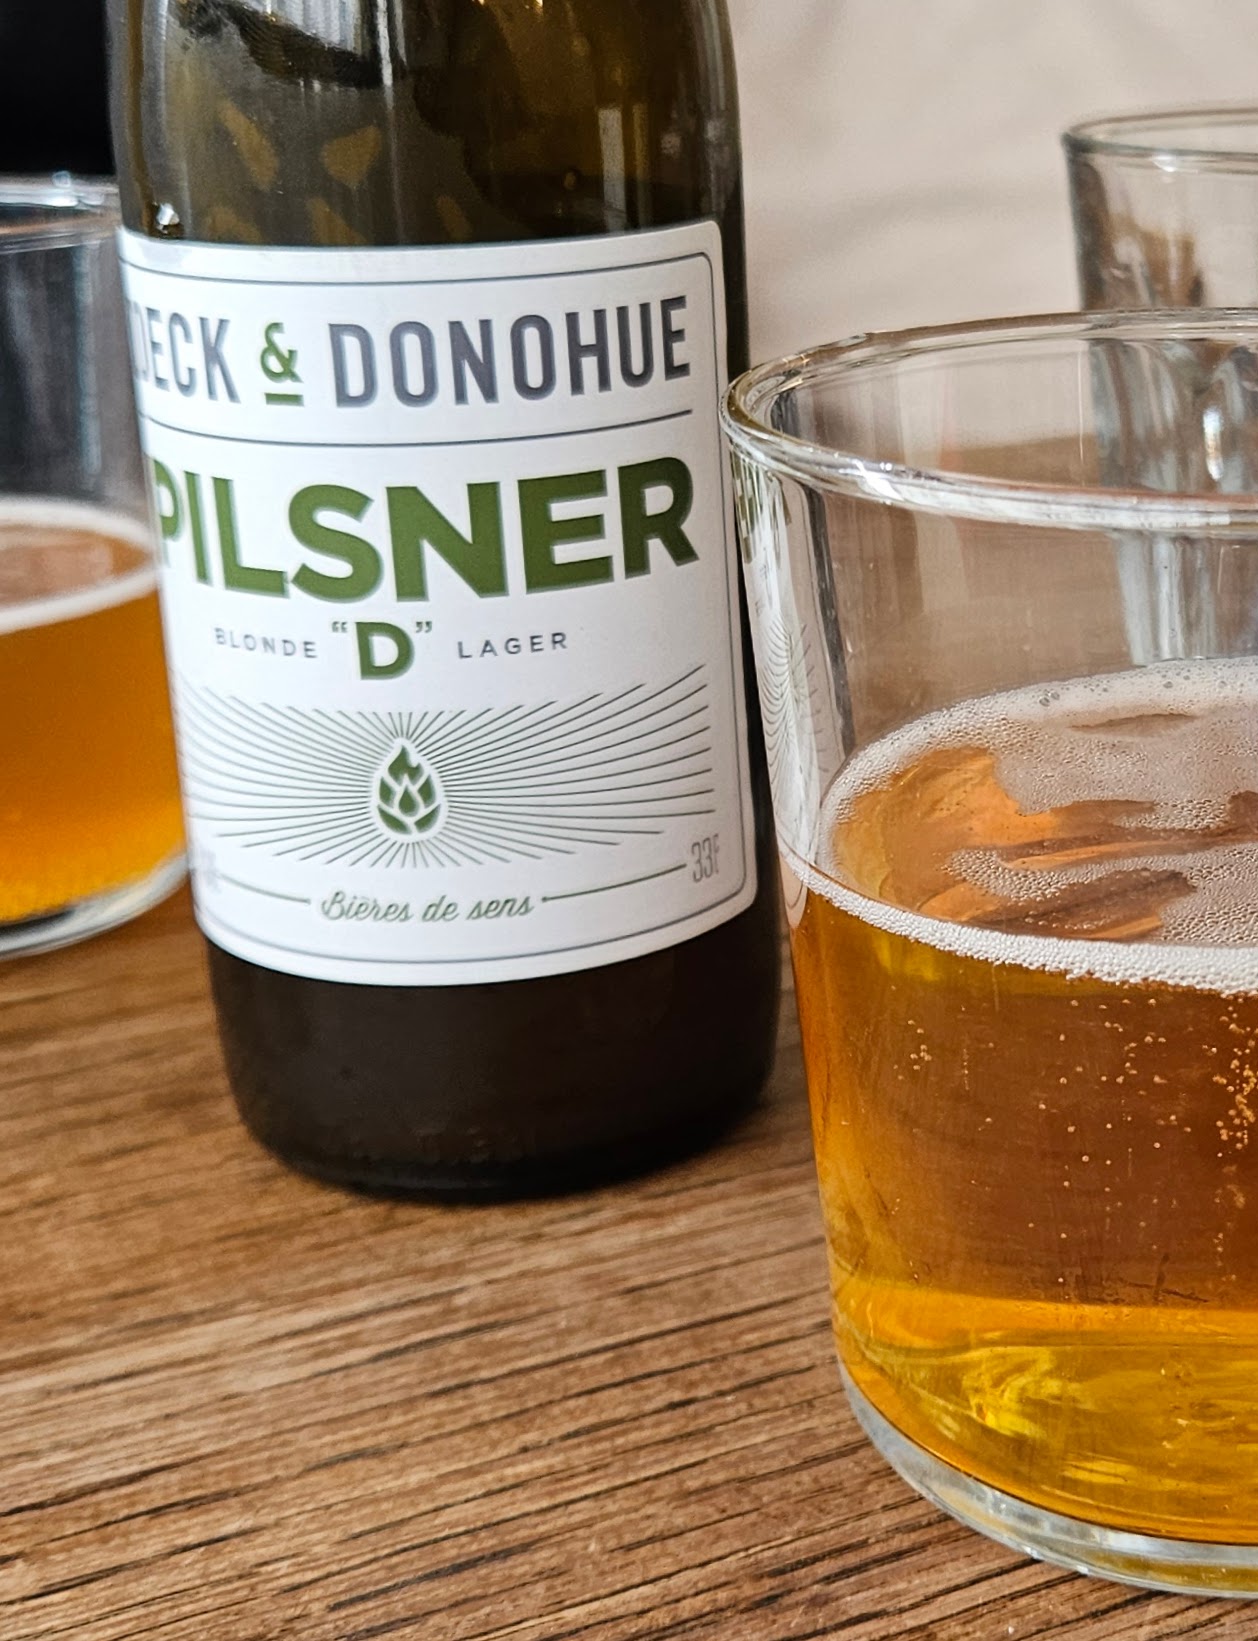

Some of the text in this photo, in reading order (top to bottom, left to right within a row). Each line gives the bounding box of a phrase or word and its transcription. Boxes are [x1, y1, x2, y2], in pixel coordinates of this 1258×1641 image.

[260, 322, 304, 406] &
[328, 295, 692, 408] DONOHUE
[153, 456, 701, 602] PILSNER
[213, 627, 319, 659] BLONDE
[457, 631, 569, 659] LAGER
[321, 890, 535, 922] Bières de sens
